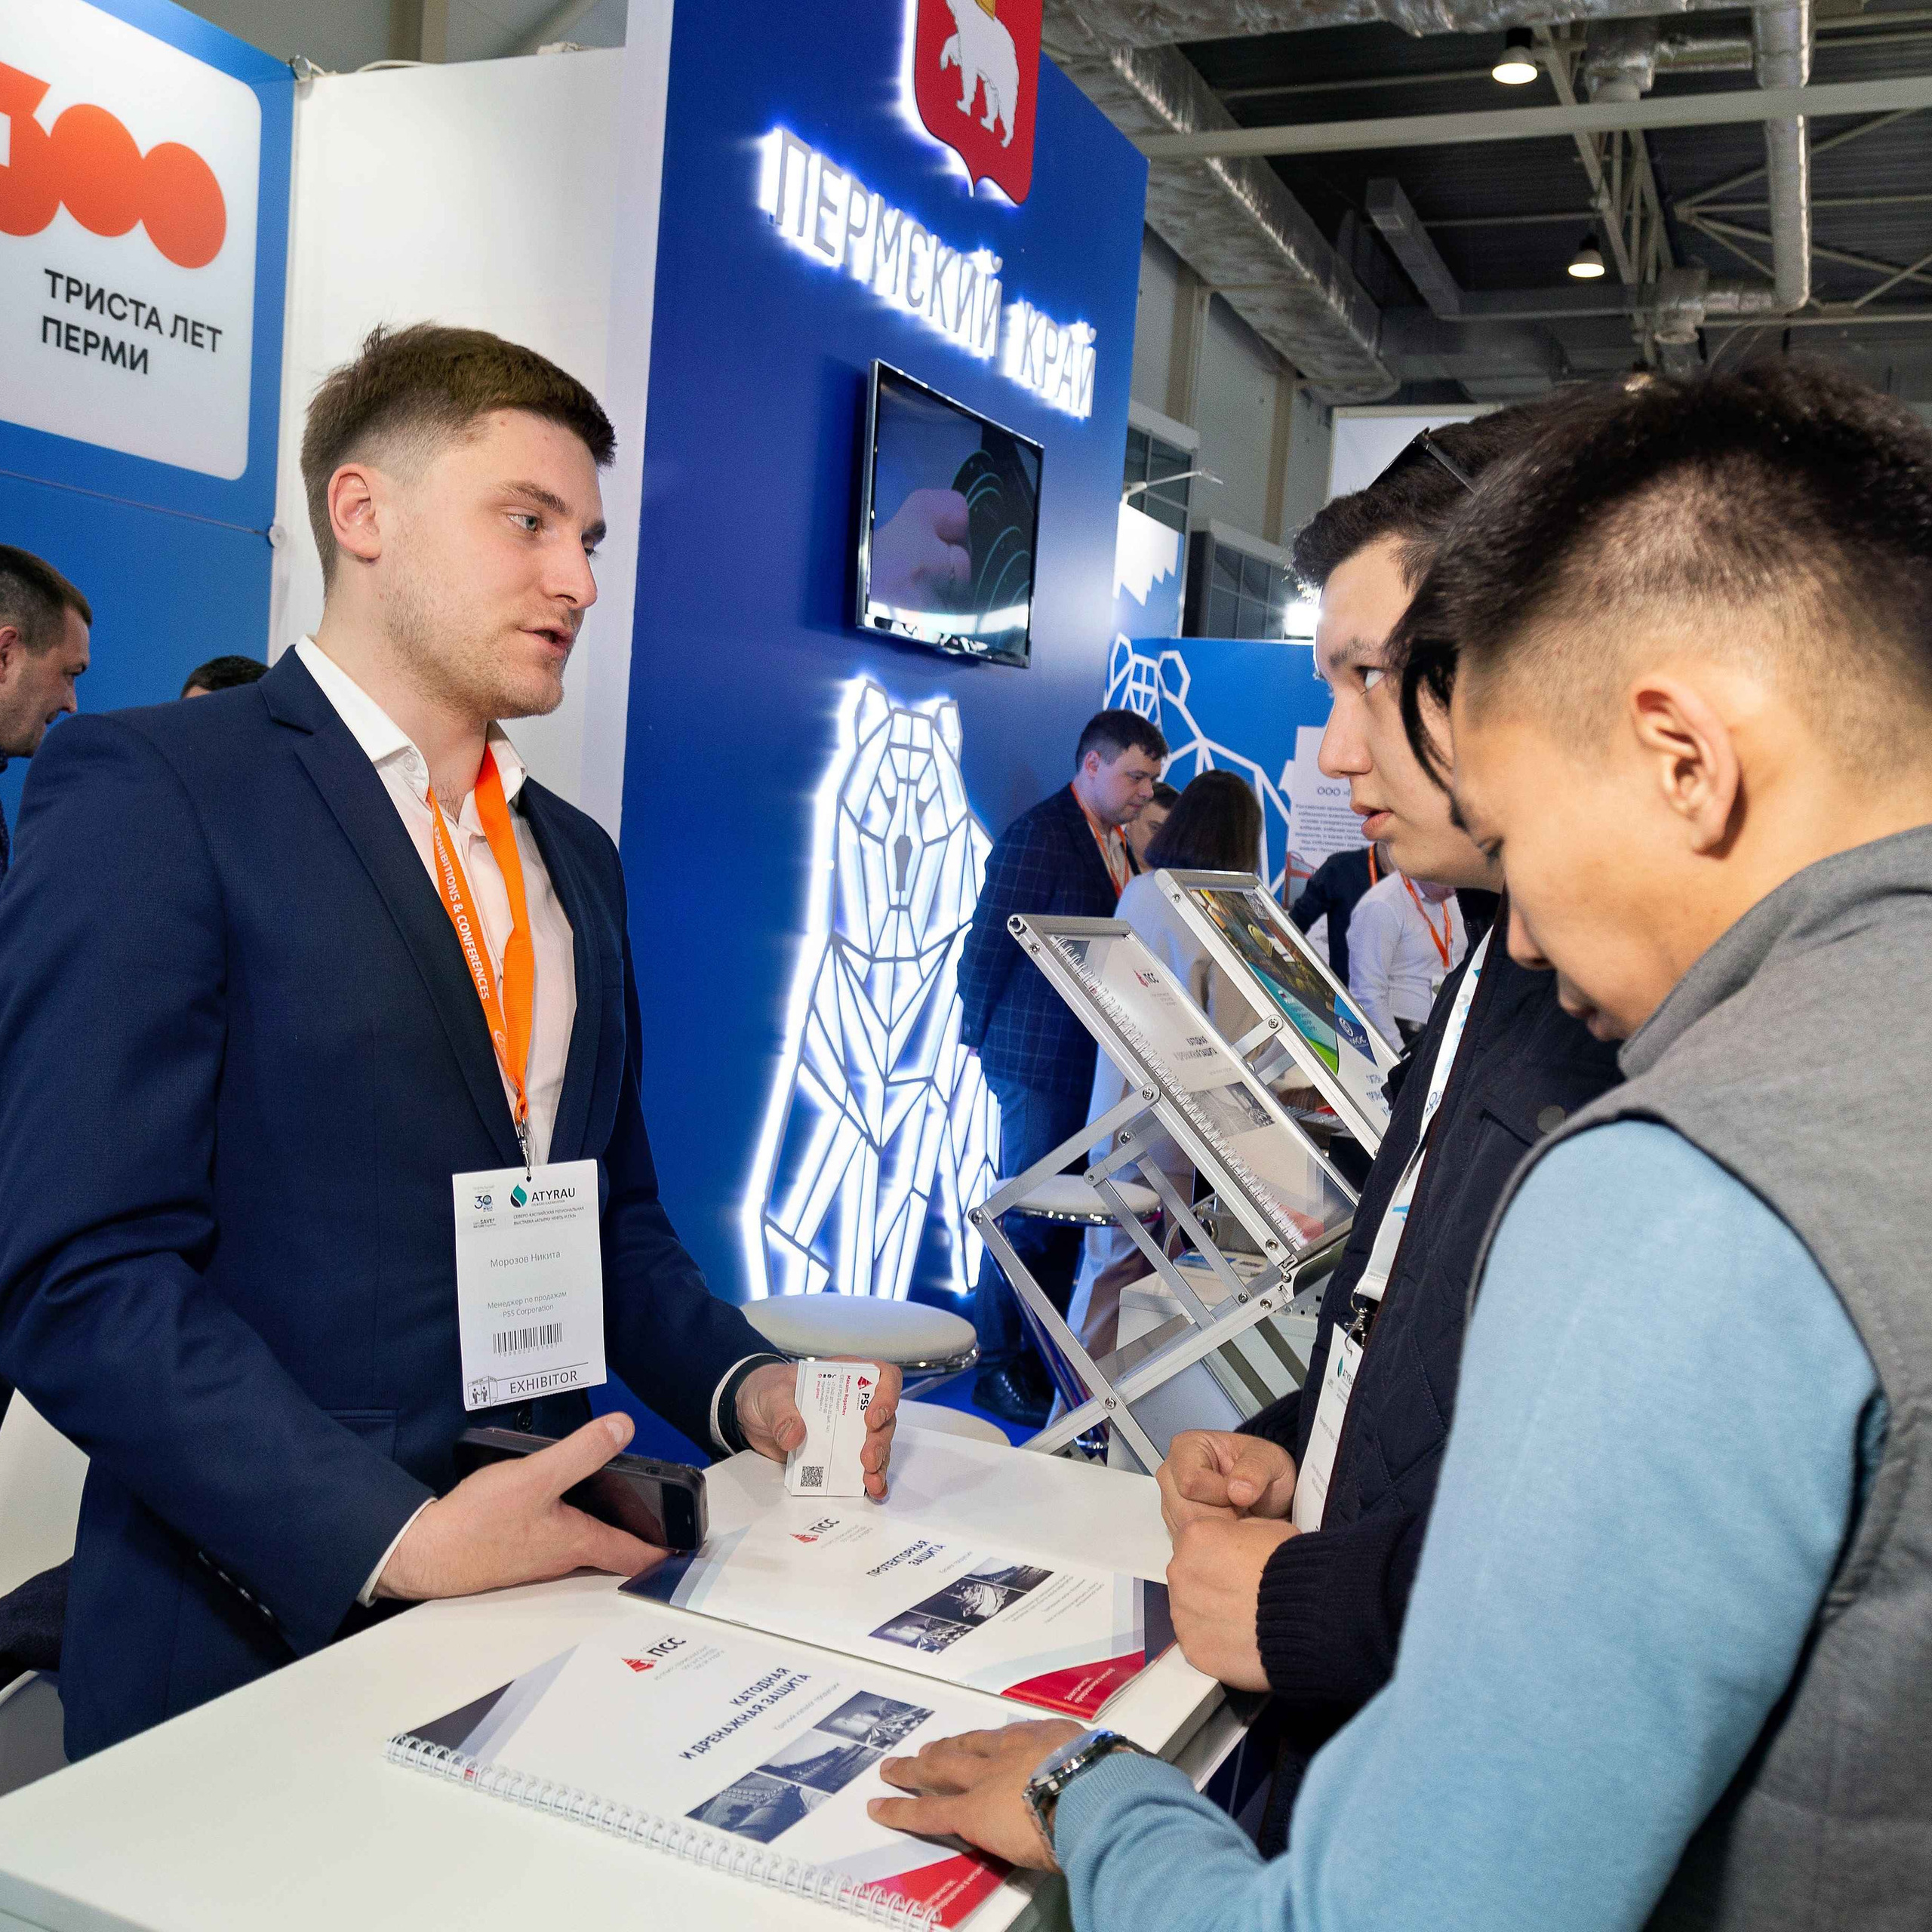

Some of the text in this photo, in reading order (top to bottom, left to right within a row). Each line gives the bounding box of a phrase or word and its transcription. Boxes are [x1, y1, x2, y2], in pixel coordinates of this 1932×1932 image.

[762, 128, 1097, 418] ПЕРМСКИЙ КРАЙ
[45, 269, 223, 353] ТРИСТА ЛЕТ
[42, 315, 149, 375] ПЕРМИ
[434, 826, 490, 1000] EXHIBITIONS & CONFERENCES
[474, 1195, 492, 1209] 30
[531, 1187, 576, 1201] ATYRAU
[491, 1251, 561, 1268] Морозов Никита
[488, 1299, 523, 1309] Менеджер
[534, 1291, 567, 1303] продажам
[516, 1304, 554, 1316] Corporation
[509, 1371, 578, 1394] EXHIBITOR
[860, 1392, 870, 1411] PSS
[808, 1518, 840, 1534] ПСС
[866, 1540, 930, 1577] ПРОТЕКТОРНАЯ
[908, 1544, 946, 1566] ЗАЩИТА
[647, 1637, 687, 1657] ПСС
[729, 1667, 791, 1706] КАТОДНАЯ
[678, 1751, 697, 1760] И
[691, 1704, 767, 1755] ДРЕНАЖНАЯ
[761, 1674, 811, 1705] ЗАЩИТА
